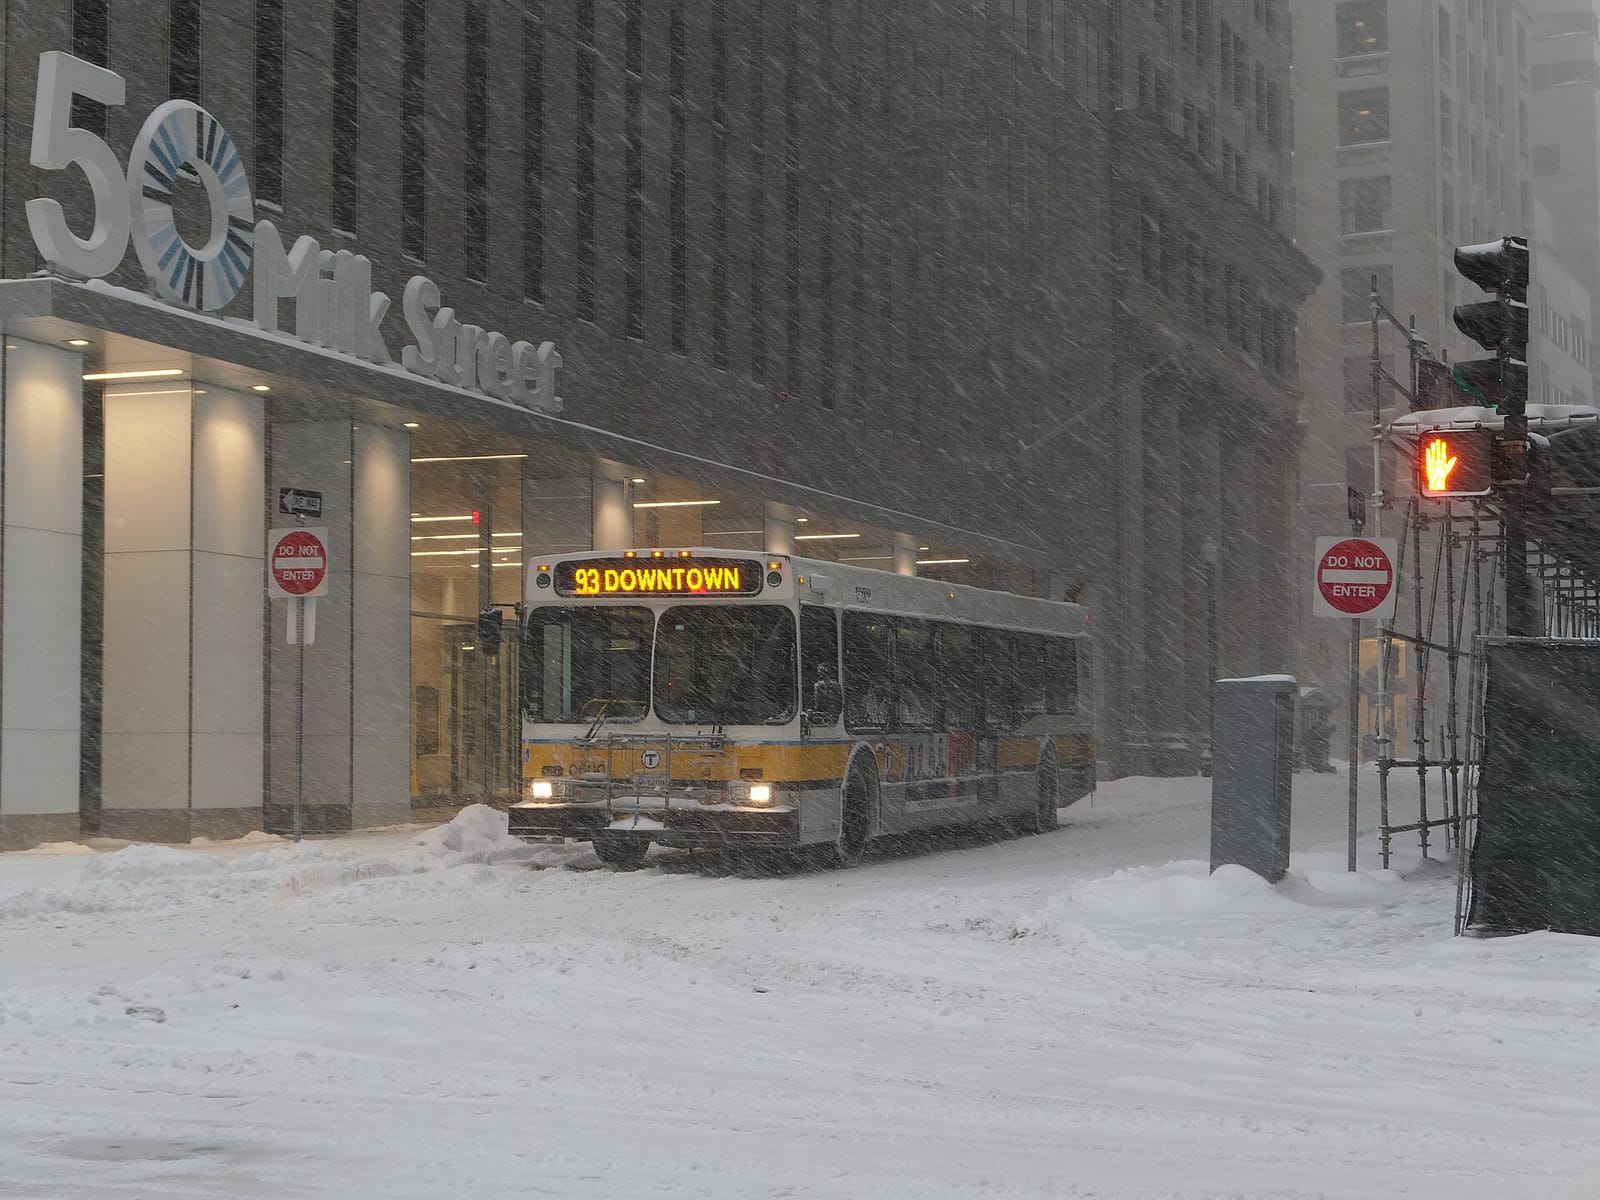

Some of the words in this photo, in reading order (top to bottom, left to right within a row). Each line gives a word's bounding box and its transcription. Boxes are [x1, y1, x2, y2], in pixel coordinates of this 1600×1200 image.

[25, 51, 254, 312] 50
[253, 219, 392, 363] Milk
[402, 275, 563, 413] Street
[279, 545, 294, 556] DO
[298, 545, 319, 556] NOT
[1328, 556, 1348, 568] DO
[1354, 556, 1383, 568] NOT
[282, 570, 315, 581] ENTER
[575, 568, 600, 593] 93
[604, 568, 739, 590] DOWNTOWN
[1332, 585, 1376, 598] ENTER
